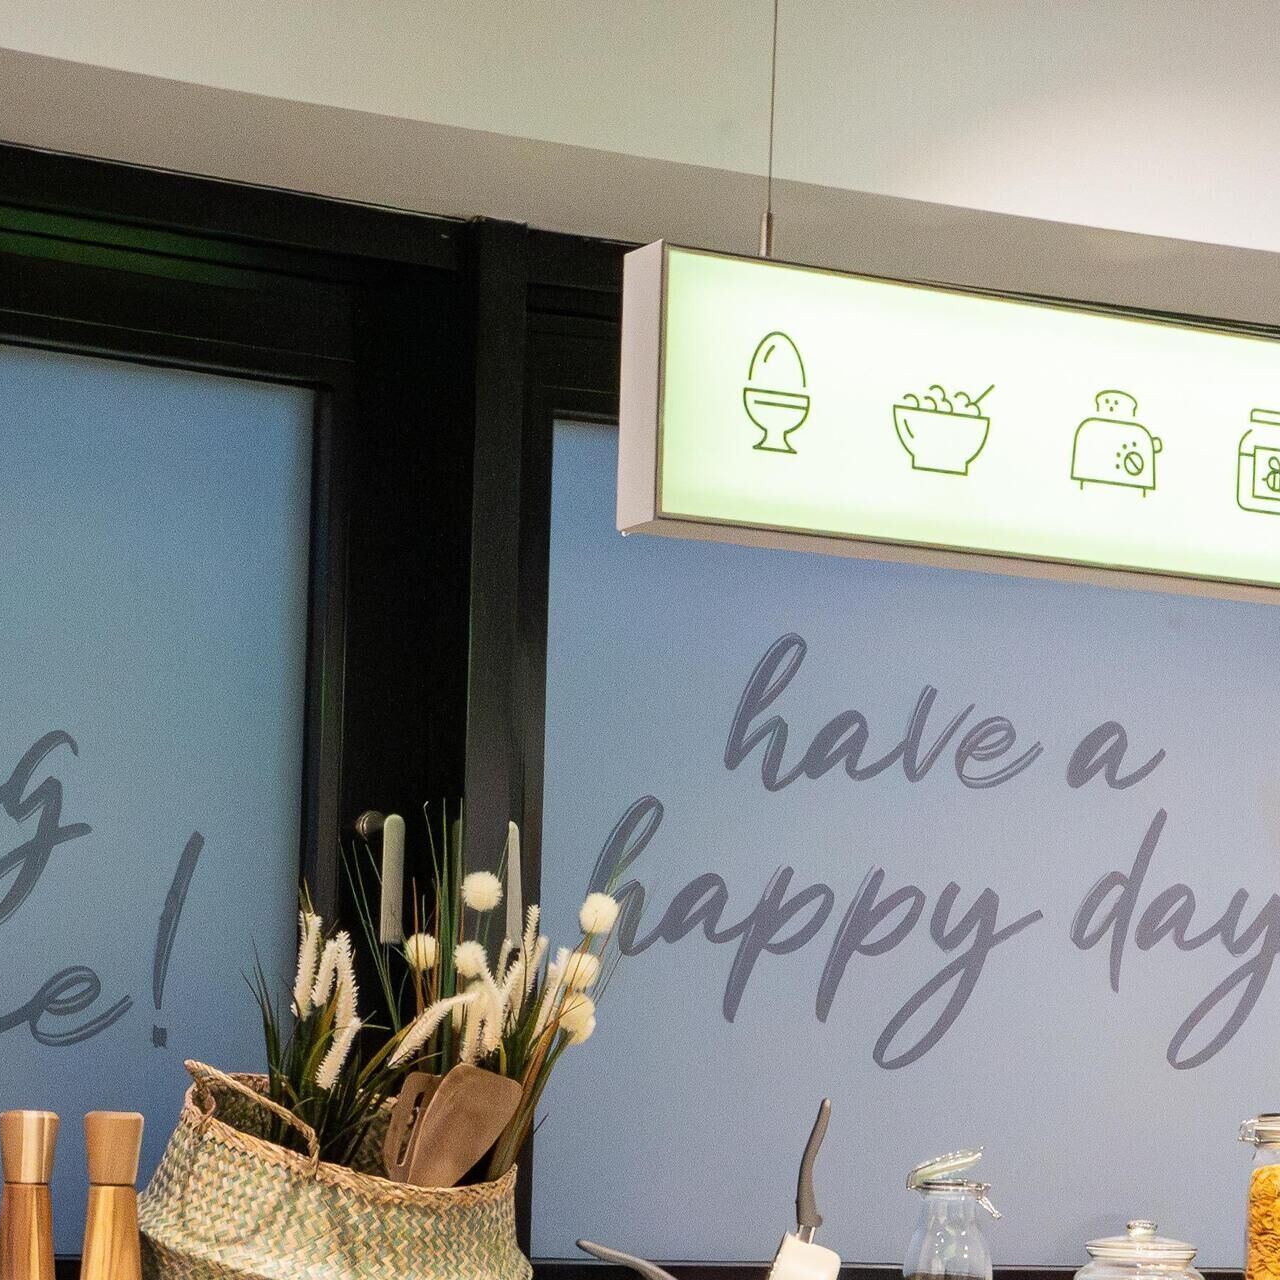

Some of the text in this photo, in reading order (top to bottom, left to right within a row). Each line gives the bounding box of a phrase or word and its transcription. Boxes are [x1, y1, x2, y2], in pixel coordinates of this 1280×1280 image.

[723, 632, 1166, 792] have a
[588, 794, 1044, 1070] happy
